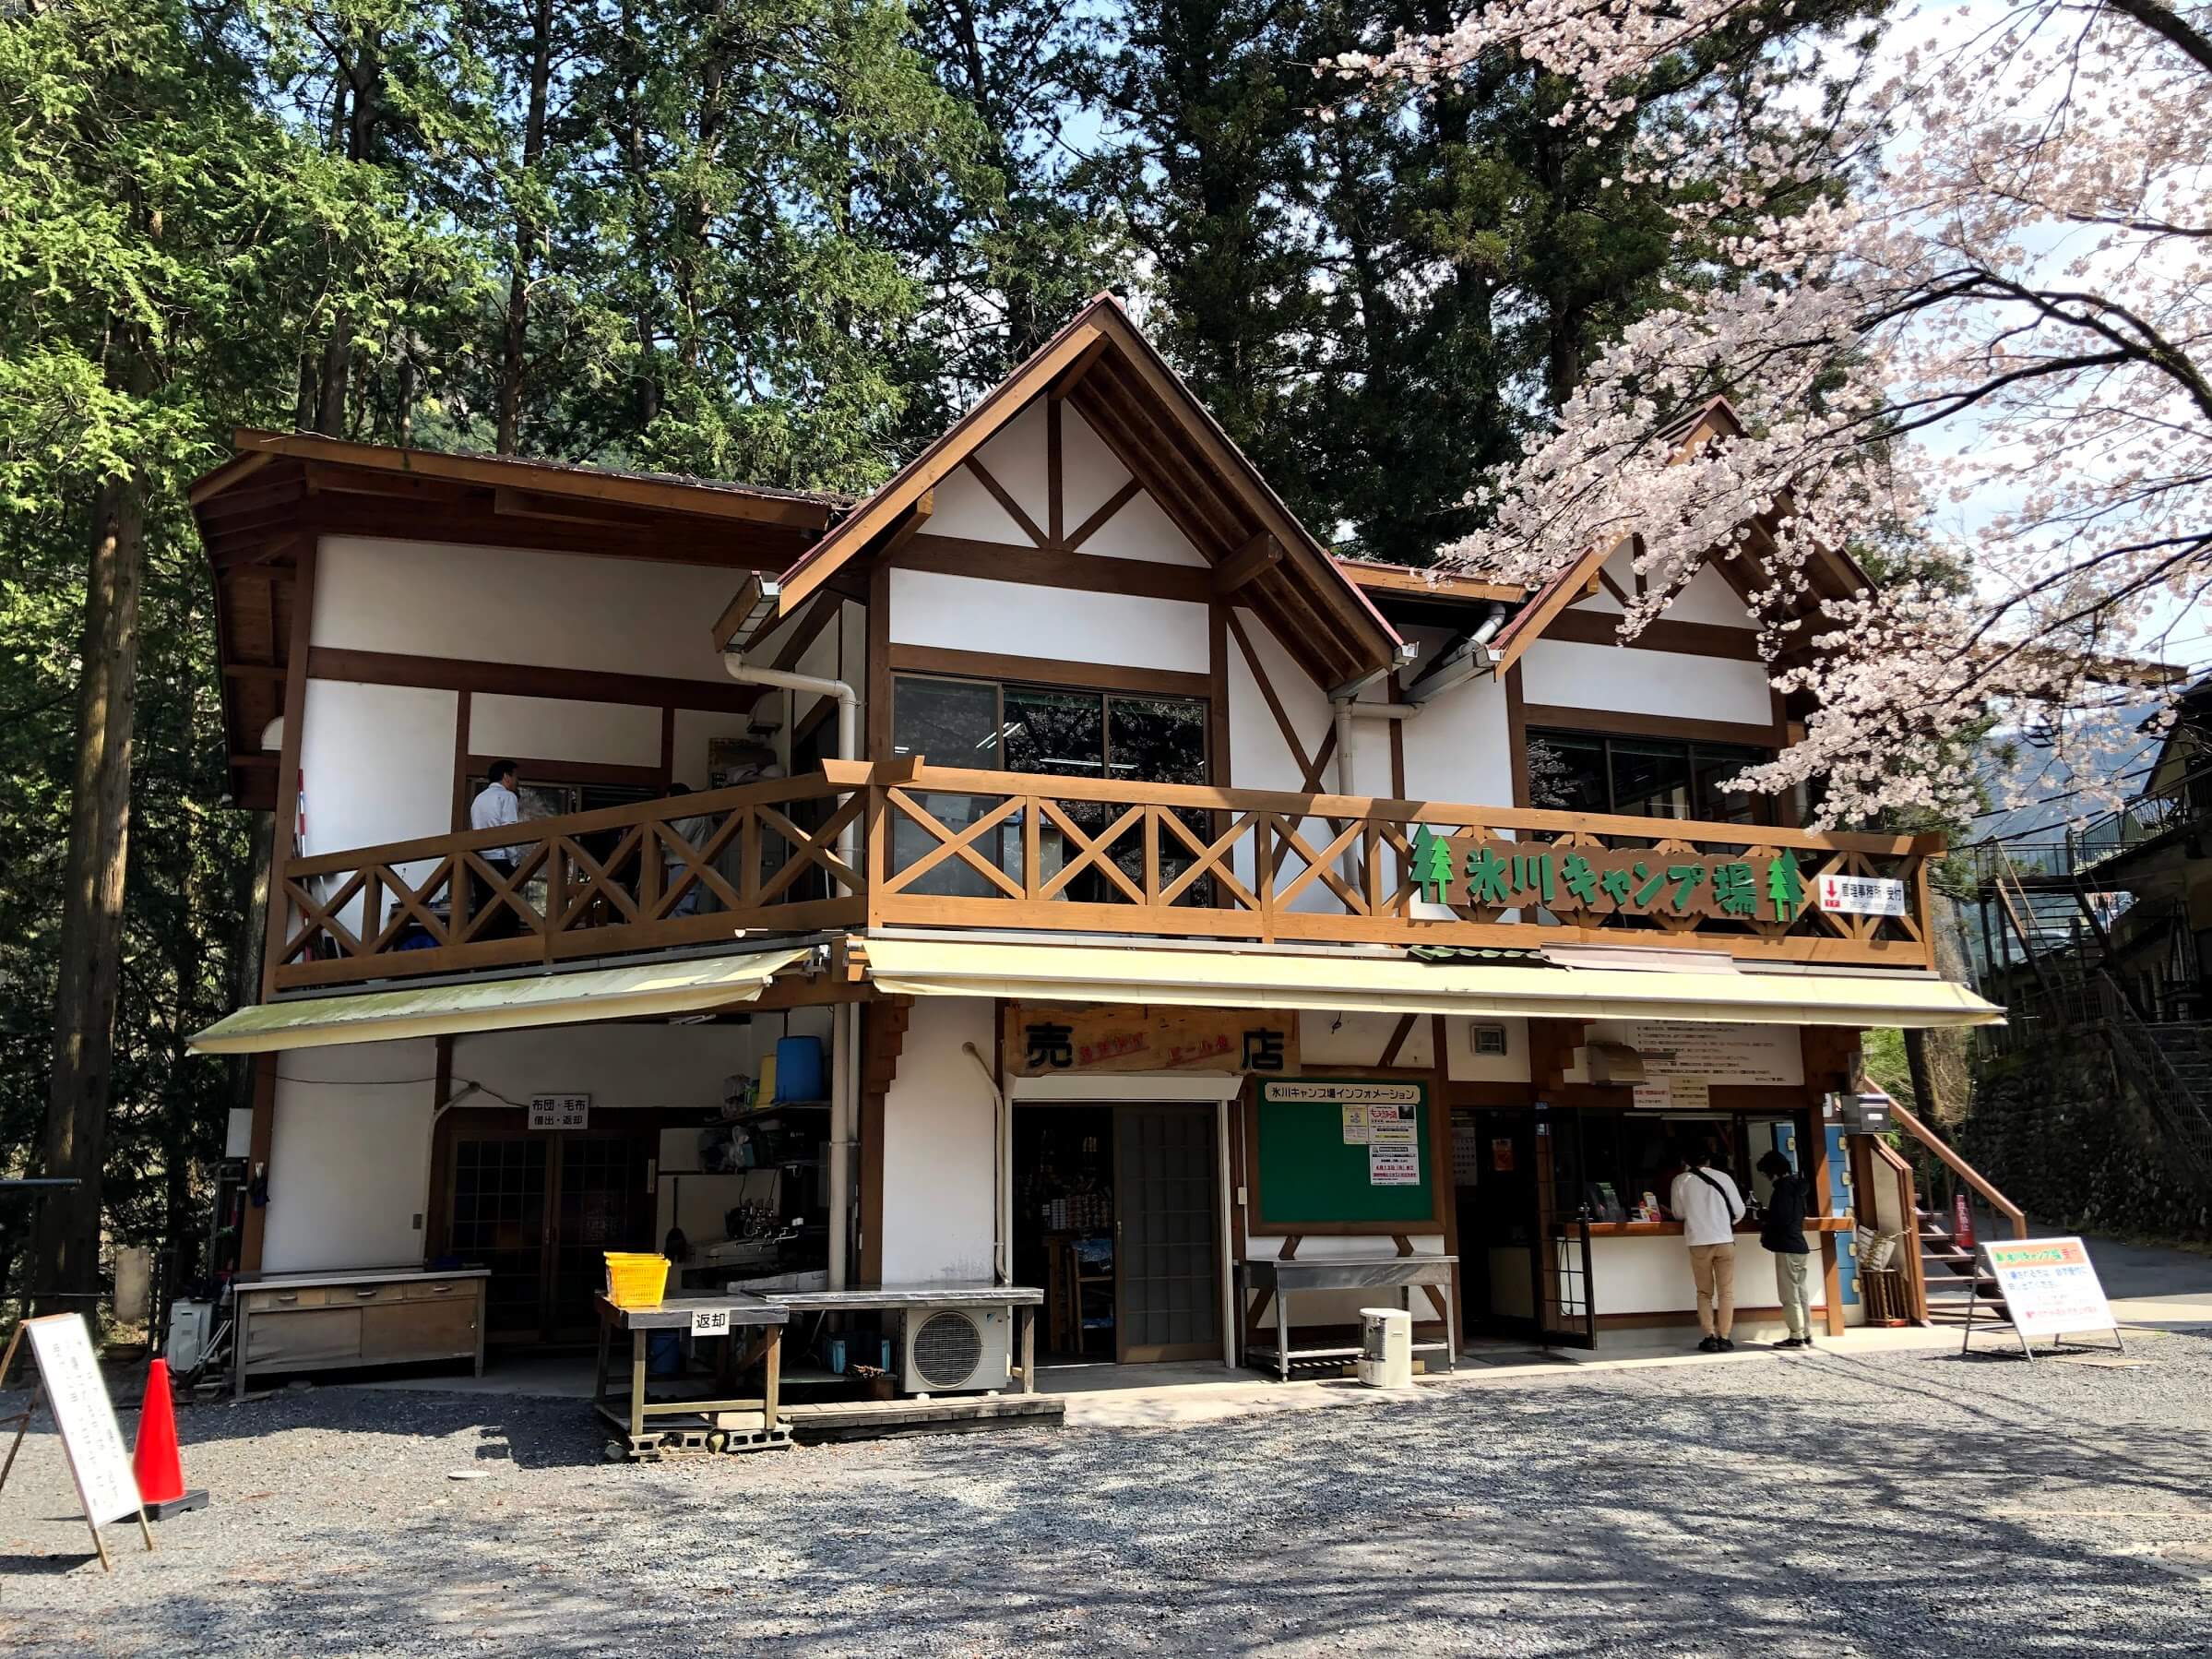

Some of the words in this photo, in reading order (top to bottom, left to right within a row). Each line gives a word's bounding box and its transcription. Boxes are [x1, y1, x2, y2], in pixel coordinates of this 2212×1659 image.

[1468, 847, 1756, 915] 氷川キャンプ場
[1271, 1086, 1414, 1100] 氷川キャンプ場インフォメーション
[696, 1313, 726, 1330] 返却
